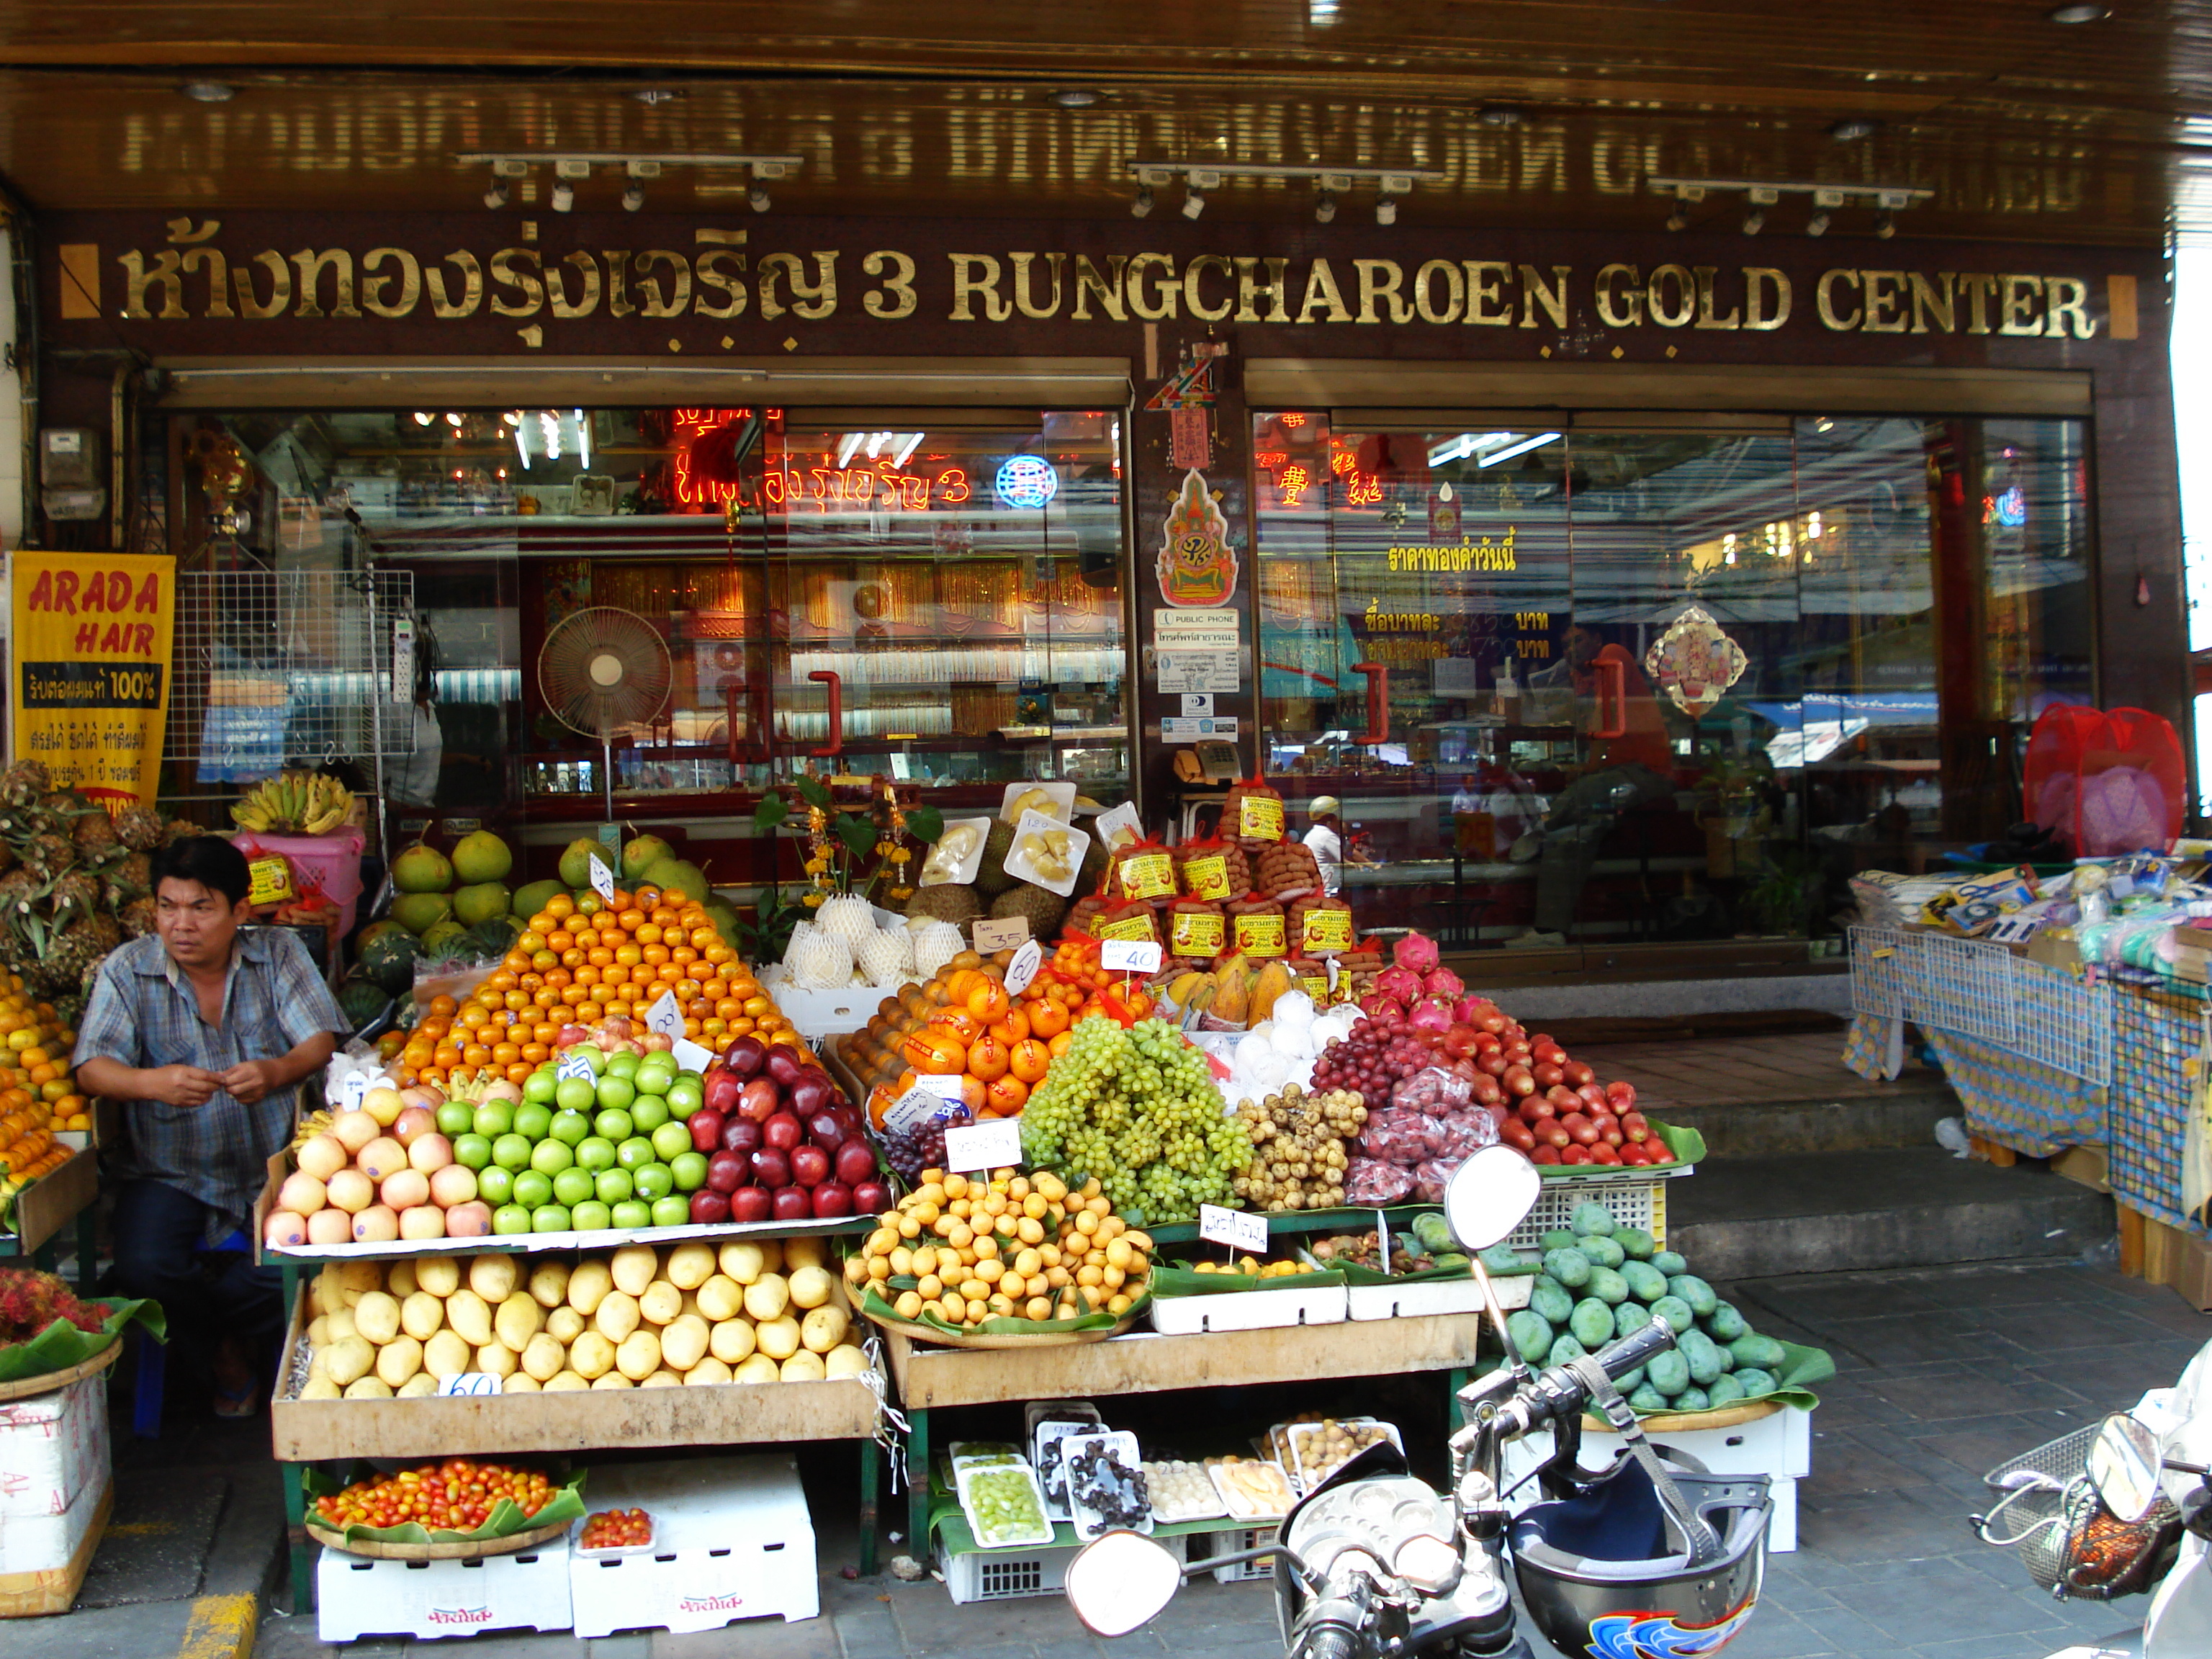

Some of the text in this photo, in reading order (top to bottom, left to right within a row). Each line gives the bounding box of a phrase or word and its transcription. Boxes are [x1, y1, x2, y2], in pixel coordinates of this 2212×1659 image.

[863, 250, 917, 319] 3
[948, 250, 2098, 341] RUNGCHAROEN GOLD CENTER
[938, 469, 969, 503] 3
[1388, 526, 1516, 572] ราคาทองคำวันนี้
[30, 570, 158, 616] ARADA
[1516, 612, 1548, 631] บาท
[75, 622, 155, 657] HAIR
[1156, 630, 1236, 642] โทรศัพท์สาธารณะ
[1516, 639, 1550, 659] บาท
[110, 671, 155, 701] 100%
[1028, 819, 1048, 828] 120
[983, 932, 1022, 950] 35
[1126, 950, 1154, 966] 40
[450, 1373, 495, 1396] 60
